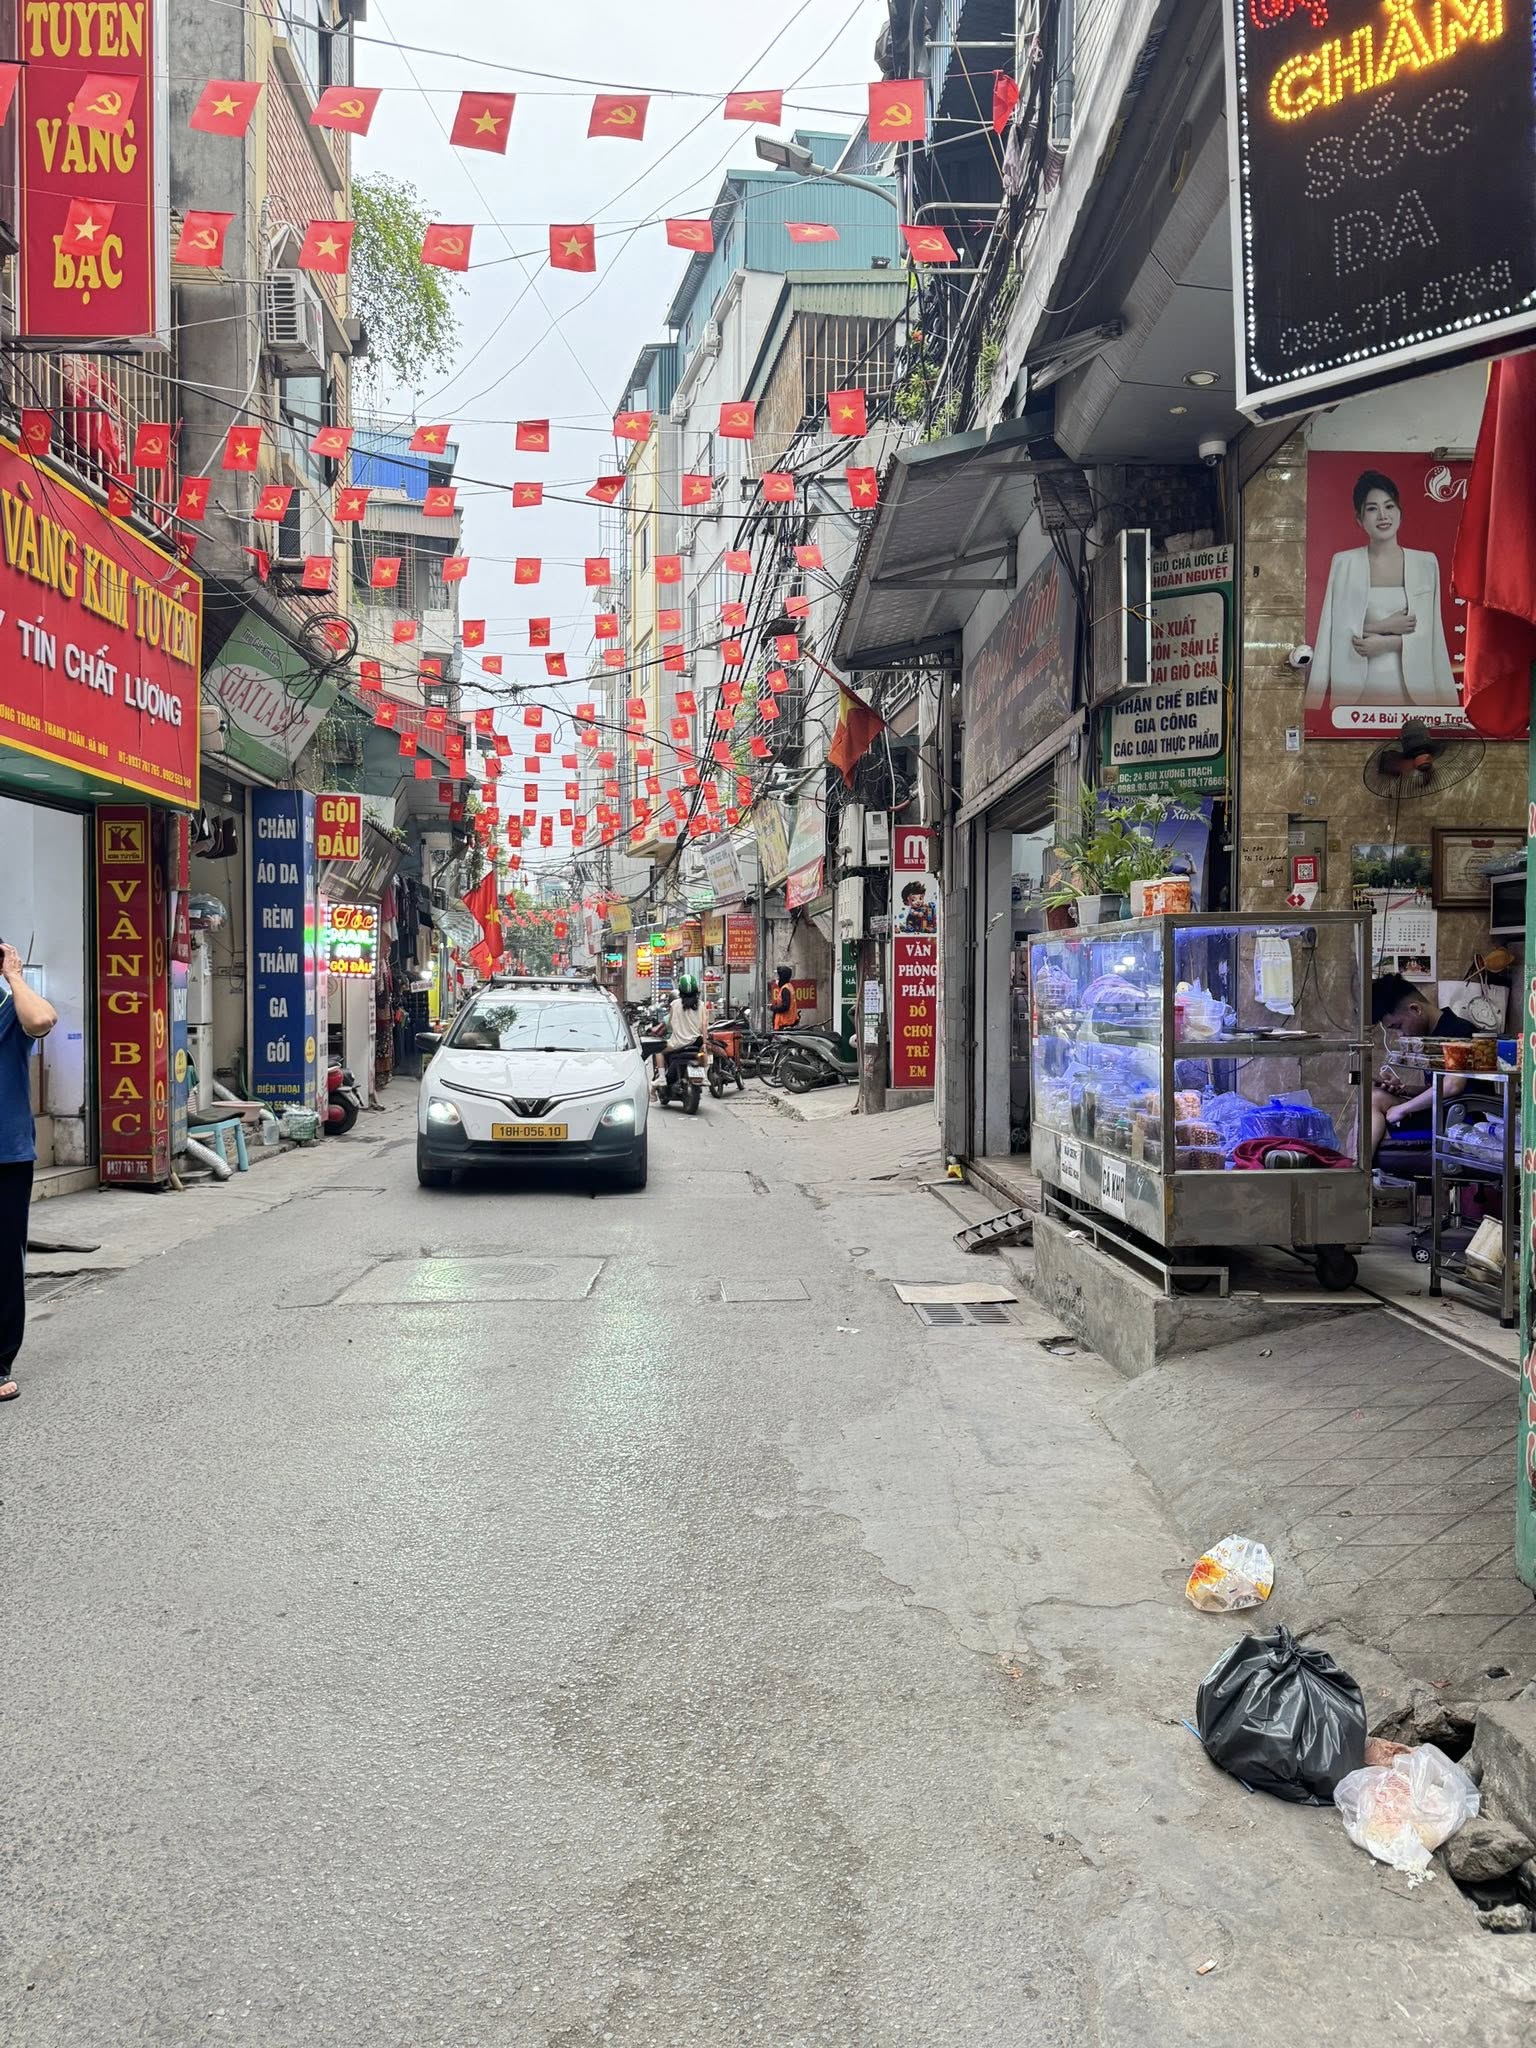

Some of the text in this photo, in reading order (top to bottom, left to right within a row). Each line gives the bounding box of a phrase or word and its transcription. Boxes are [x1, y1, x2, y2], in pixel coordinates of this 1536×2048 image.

[1, 481, 198, 667] VÀNG KIM TUYẾN
[1153, 564, 1228, 588] HOÀN NGUYỆT
[1167, 614, 1197, 638] XUẤT
[1180, 638, 1203, 658] BÁN
[17, 615, 182, 727] TÍN CHẤT LƯỢNG
[1156, 688, 1184, 711] CHẾ
[1186, 686, 1218, 709] BIẾN
[1134, 711, 1198, 734] GIA CÔNG
[1362, 712, 1376, 723] 24
[1379, 712, 1398, 724] Bùi
[1113, 727, 1219, 759] CÁC LOẠI THỰC PHẨM
[321, 797, 356, 829] GỘI
[257, 814, 297, 840] CHĂN
[317, 827, 359, 857] ĐẦU
[257, 858, 276, 884] ÁO
[279, 864, 299, 885] DA
[262, 903, 294, 929] RÈM
[258, 946, 299, 974] THẢM
[905, 943, 931, 957] VĂN
[898, 960, 938, 977] PHÒNG
[901, 979, 936, 998] PHẨM
[269, 998, 288, 1019] GA
[909, 998, 928, 1018] ĐỒ
[903, 1022, 933, 1038] CHƠI
[266, 1034, 290, 1063] GỐI
[906, 1041, 930, 1059] TRẺ
[909, 1065, 927, 1078] EM
[277, 1084, 301, 1096] THOẠI
